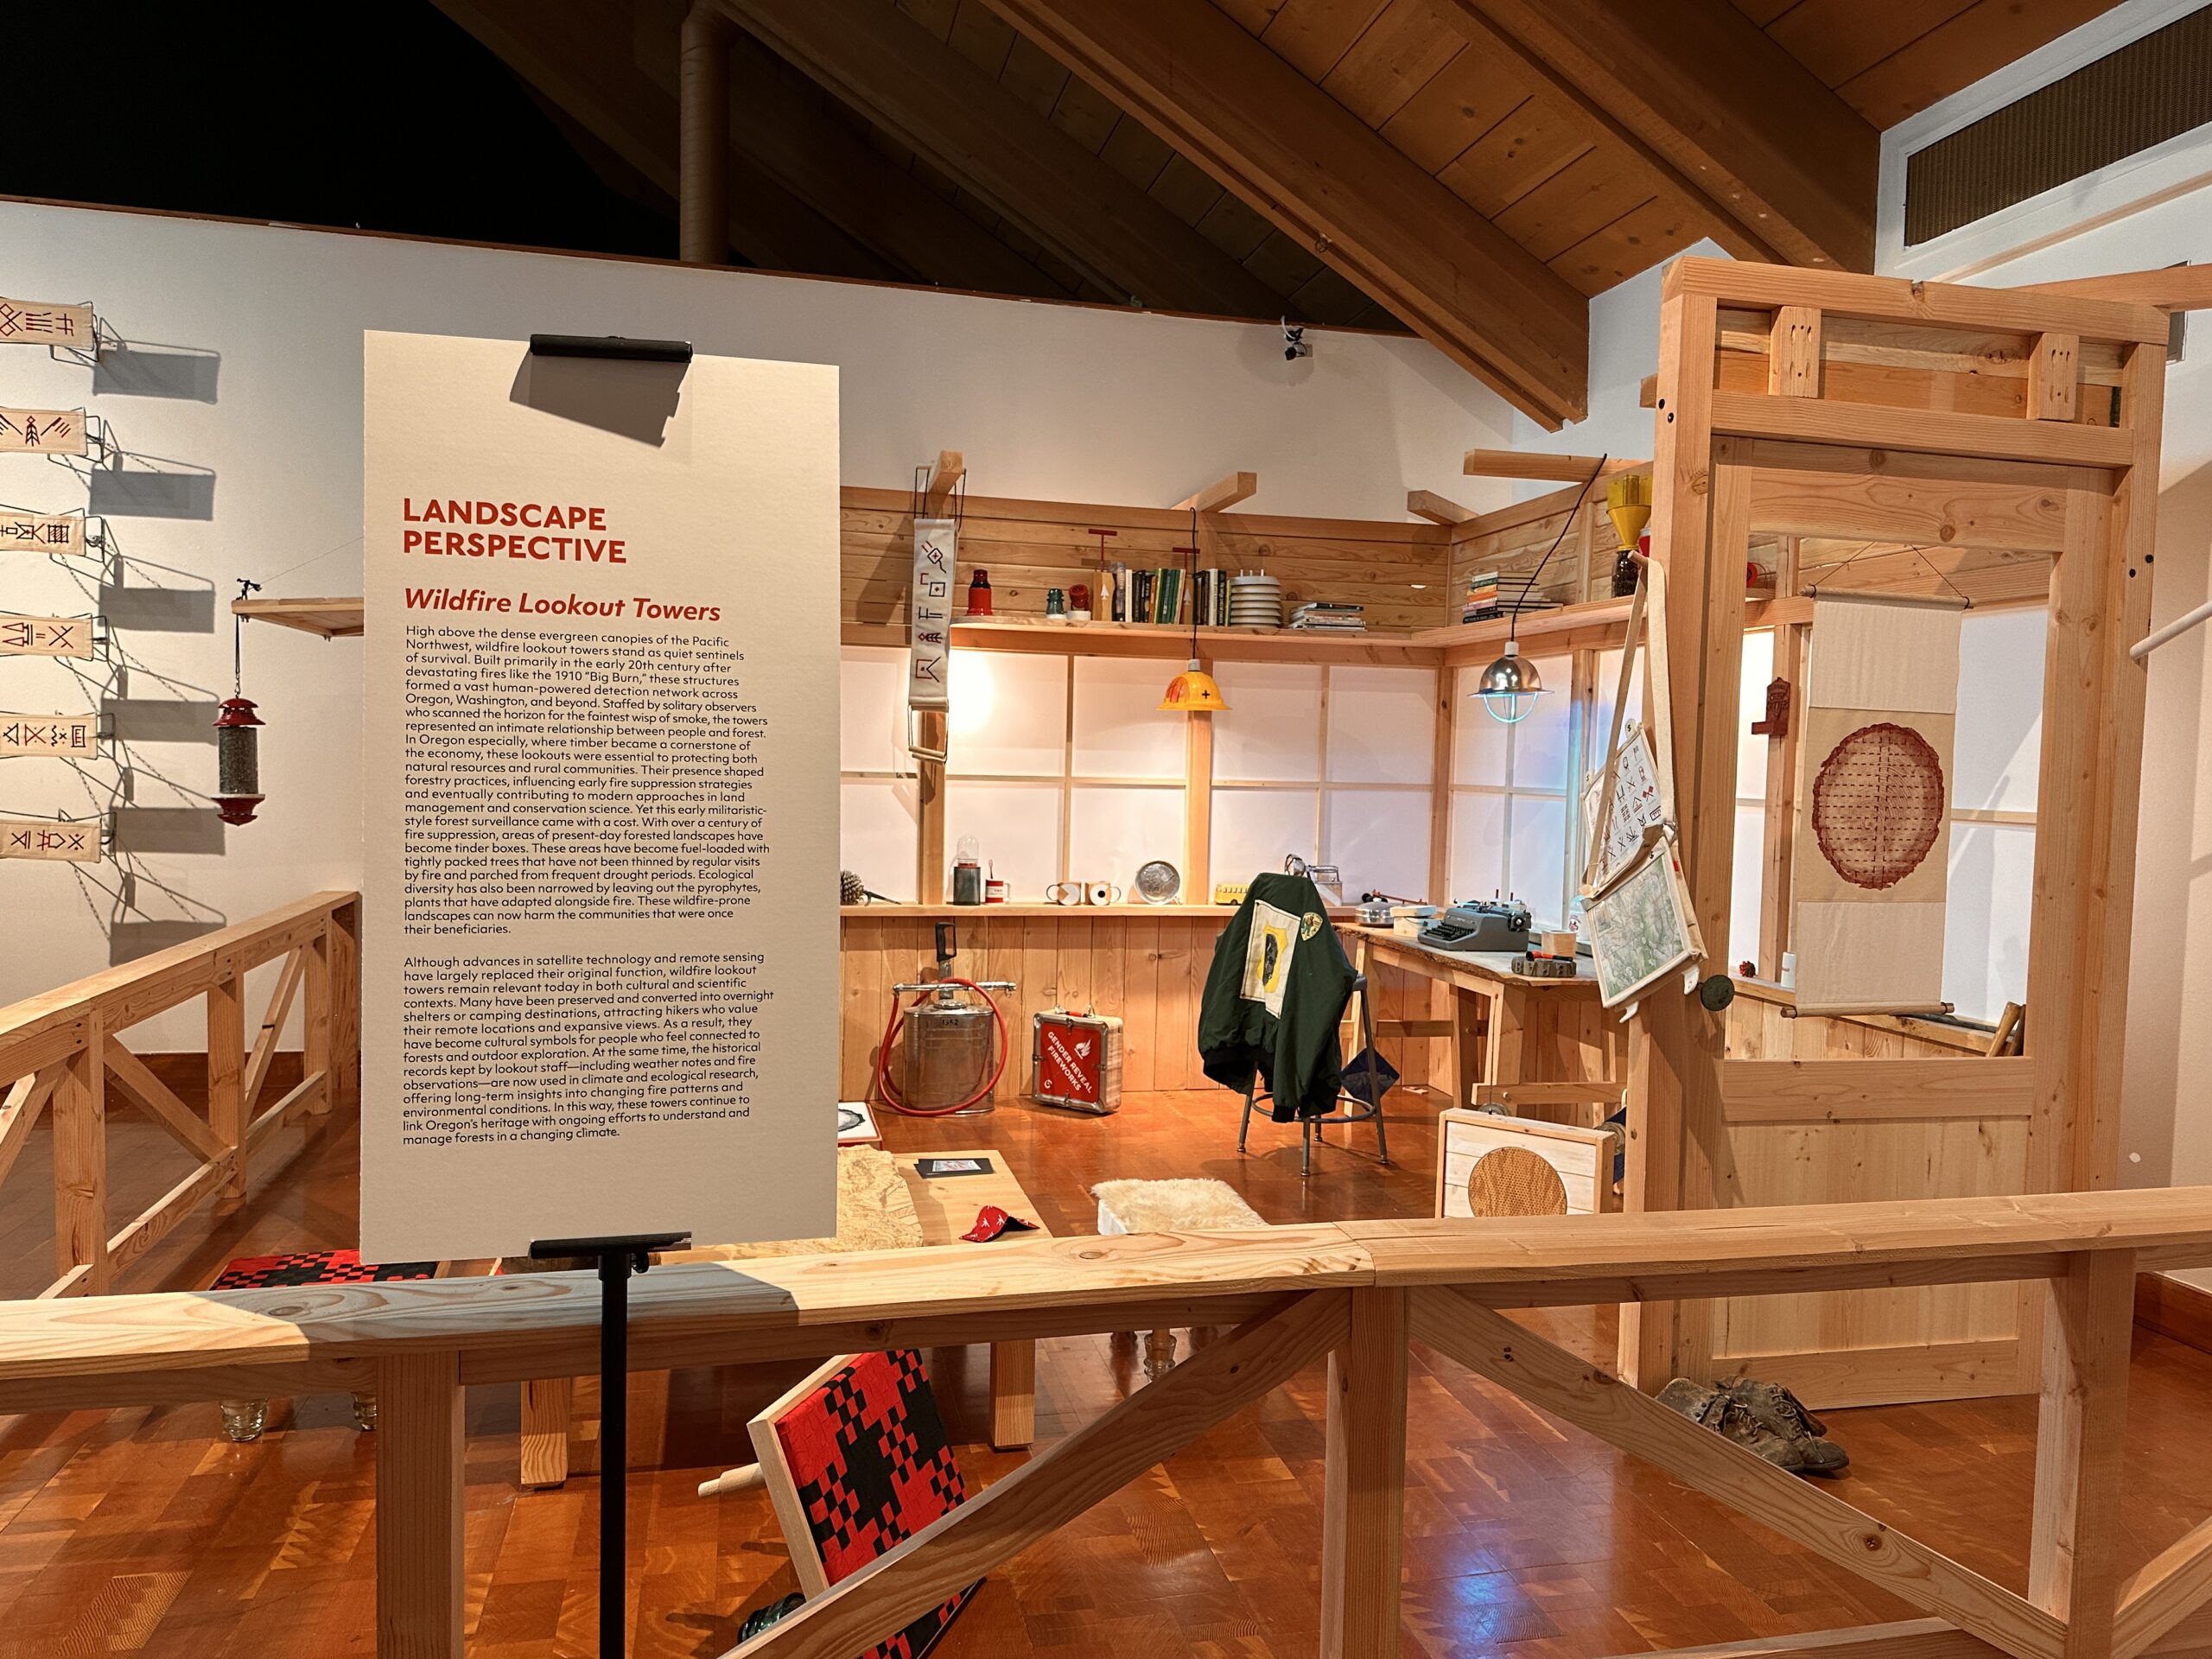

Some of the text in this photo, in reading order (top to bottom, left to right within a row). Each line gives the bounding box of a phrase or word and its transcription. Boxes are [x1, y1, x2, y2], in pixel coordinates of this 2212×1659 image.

[404, 498, 607, 531] LANDSCAPE
[404, 531, 626, 563] PERSPECTIVE
[405, 588, 720, 621] Wildfire Lookout Towers
[406, 624, 729, 647] High above the dense evergreen canopies of the Pacific
[405, 652, 731, 675] of survival. Built primarily in the early 20th century after
[405, 678, 450, 690] formed
[464, 680, 490, 691] vast
[493, 681, 591, 697] human-powered
[594, 683, 649, 696] detection
[652, 685, 699, 697] network
[702, 690, 738, 699] across
[405, 705, 768, 726] who scanned the horizon for the faintest wisp of smoke, the towers
[405, 733, 751, 751] In Oregon especially, where timber became a cornerstone of
[405, 760, 764, 779] natural resources and rural communities. Their presence shaped
[404, 814, 433, 829] style
[435, 814, 469, 826] forest
[471, 815, 539, 826] surveillance
[576, 816, 601, 827] with
[603, 818, 611, 827] a
[613, 816, 639, 827] cost.
[642, 816, 669, 827] With
[708, 816, 749, 830] century
[751, 817, 762, 828] of
[404, 842, 452, 853] become
[454, 842, 490, 853] tinder
[492, 842, 529, 853] boxes.
[532, 842, 566, 853] These
[603, 842, 632, 853] have
[633, 842, 679, 853] become
[680, 842, 745, 853] fuel-loaded
[747, 842, 770, 853] with
[404, 880, 760, 897] diversity has also been narrowed by leaving out the pyrophytes,
[404, 909, 471, 924] landscapes
[473, 912, 494, 920] can
[497, 912, 522, 920] now
[524, 908, 555, 919] harm
[556, 908, 576, 919] the
[578, 907, 650, 919] communities
[652, 907, 676, 918] that
[677, 910, 705, 918] were
[404, 922, 511, 934] their beneficiaries.
[404, 950, 765, 970] Although advances in satellite technology and remote sensing
[403, 976, 747, 995] towers remain relevant today in both cultural and scientific
[404, 1010, 451, 1022] shelters
[469, 1008, 522, 1024] camping
[524, 1006, 601, 1020] destinations,
[603, 1004, 663, 1020] attracting
[665, 1003, 699, 1015] hikers
[701, 1002, 726, 1014] who
[728, 1001, 759, 1014] value
[404, 1027, 760, 1049] have become cultural symbols for people who feel connected to
[1047, 1031, 1093, 1094] GENDER REVEAL
[1047, 1045, 1082, 1091] FIREWORKS
[403, 1092, 750, 1117] environmental conditions. In this way, these towers continue to
